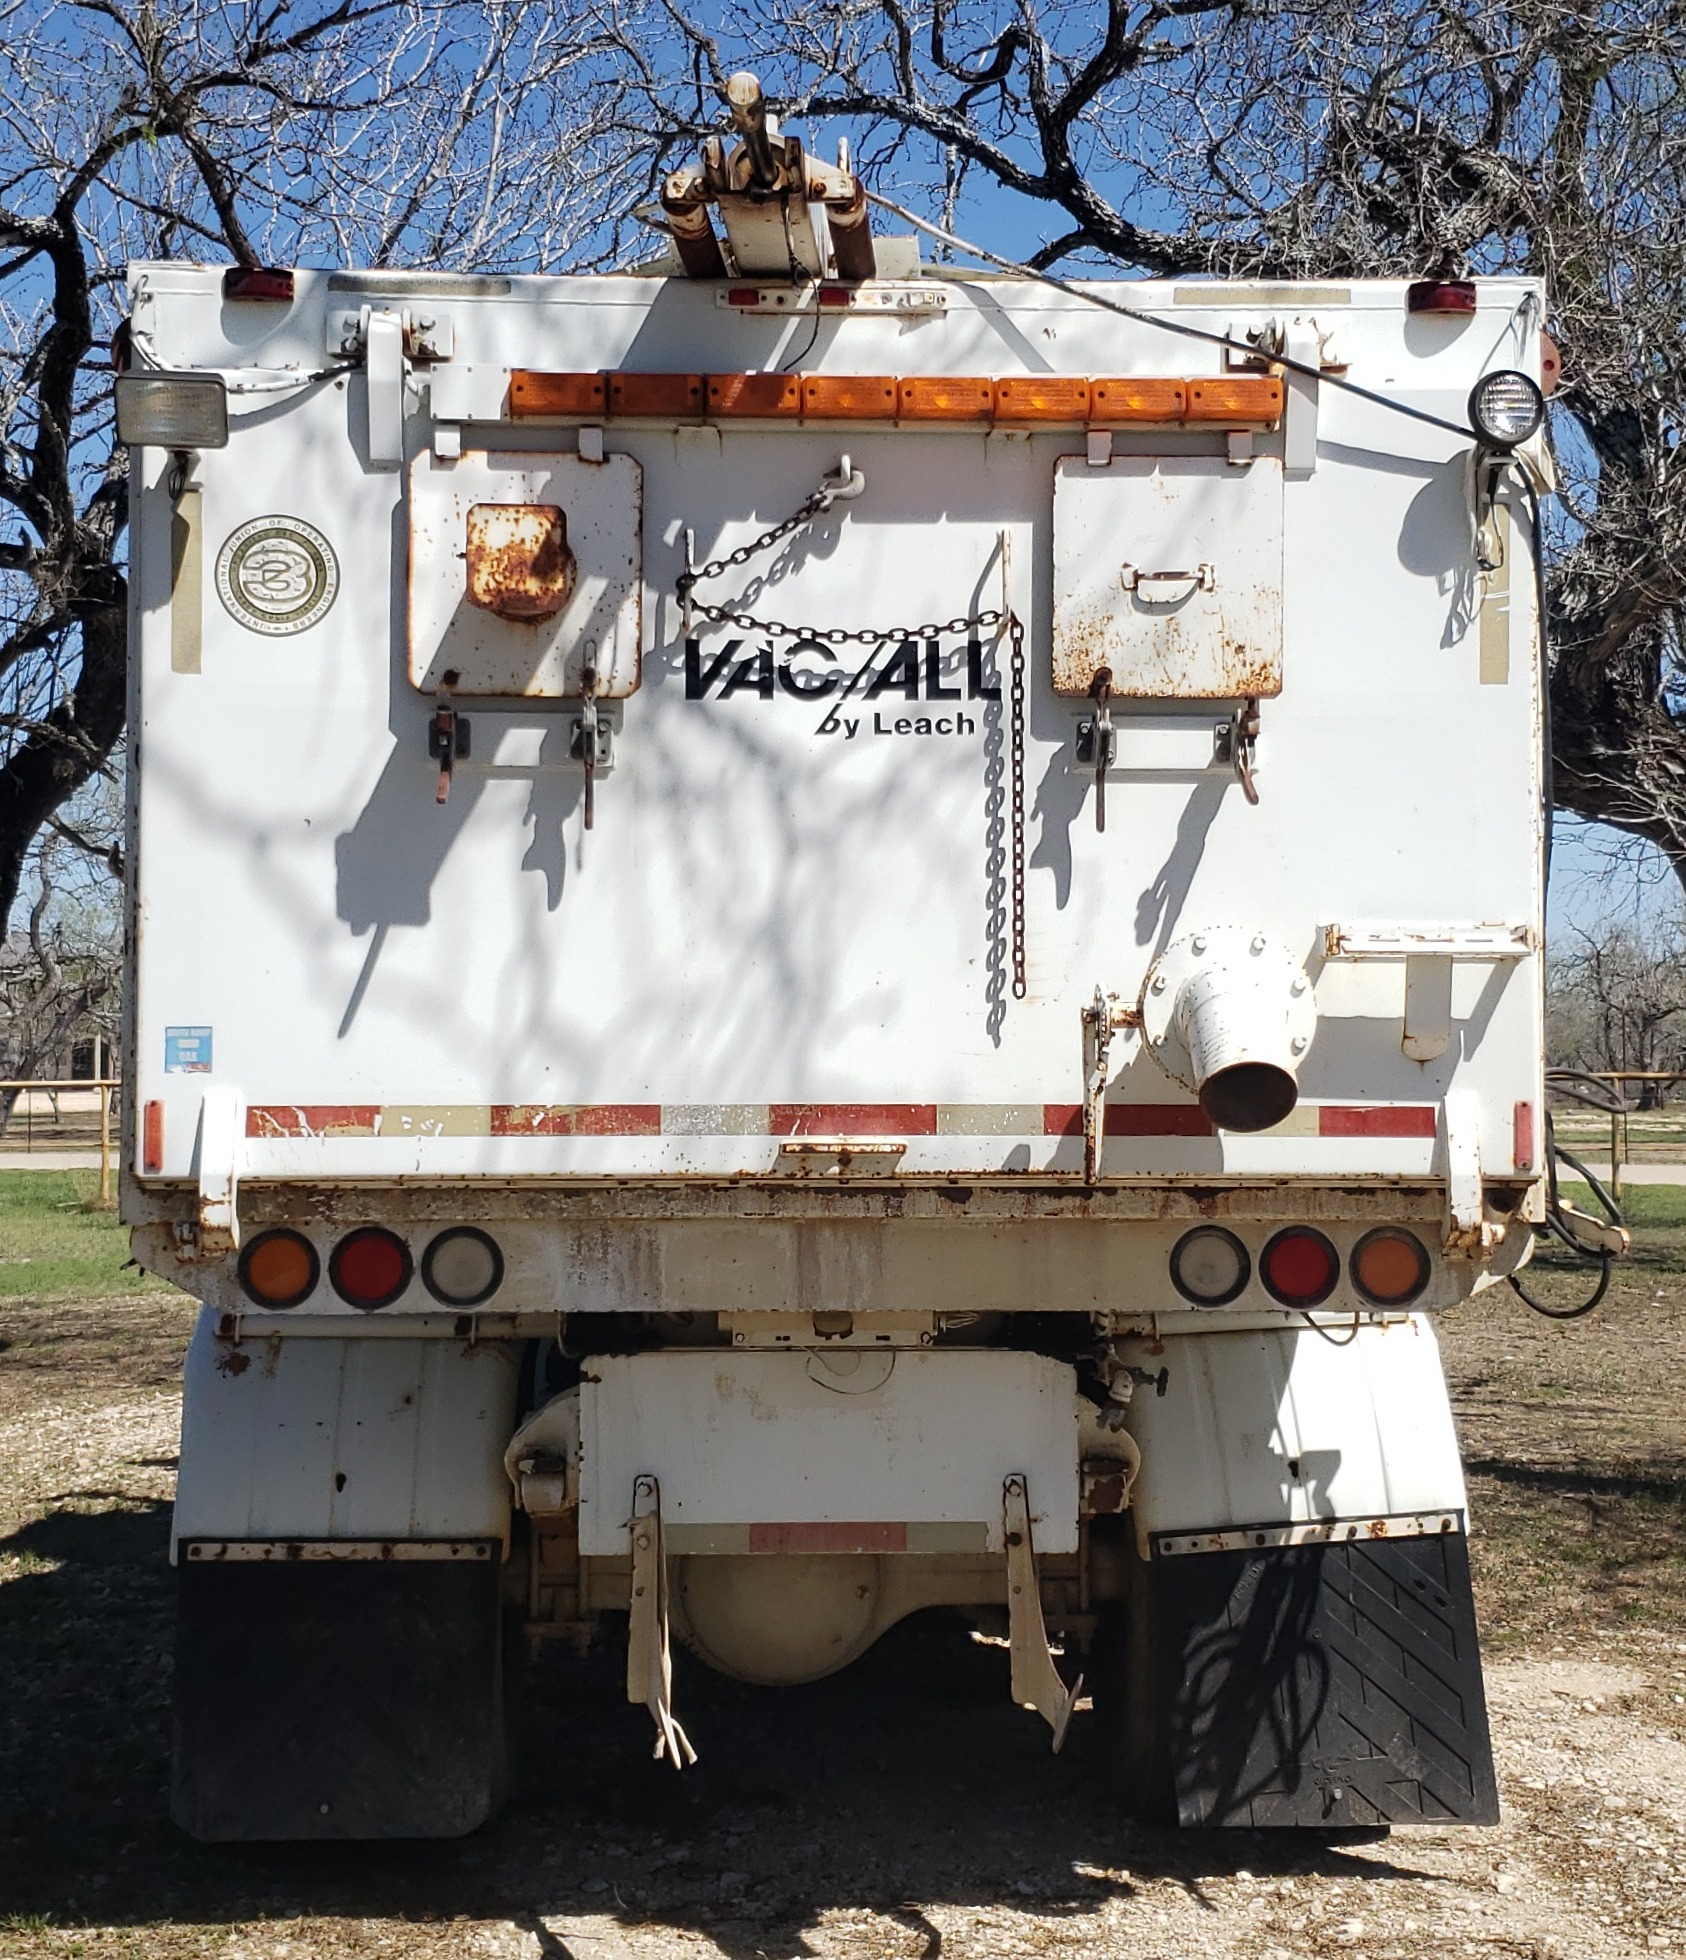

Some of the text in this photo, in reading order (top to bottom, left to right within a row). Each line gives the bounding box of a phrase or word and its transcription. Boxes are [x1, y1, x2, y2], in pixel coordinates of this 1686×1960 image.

[231, 524, 258, 549] UNION
[268, 519, 281, 527] OF
[294, 523, 335, 572] OPERATING
[220, 558, 264, 630] INTERNATIONAL
[293, 583, 334, 630] ENGINEERS
[814, 703, 975, 740] by Leach
